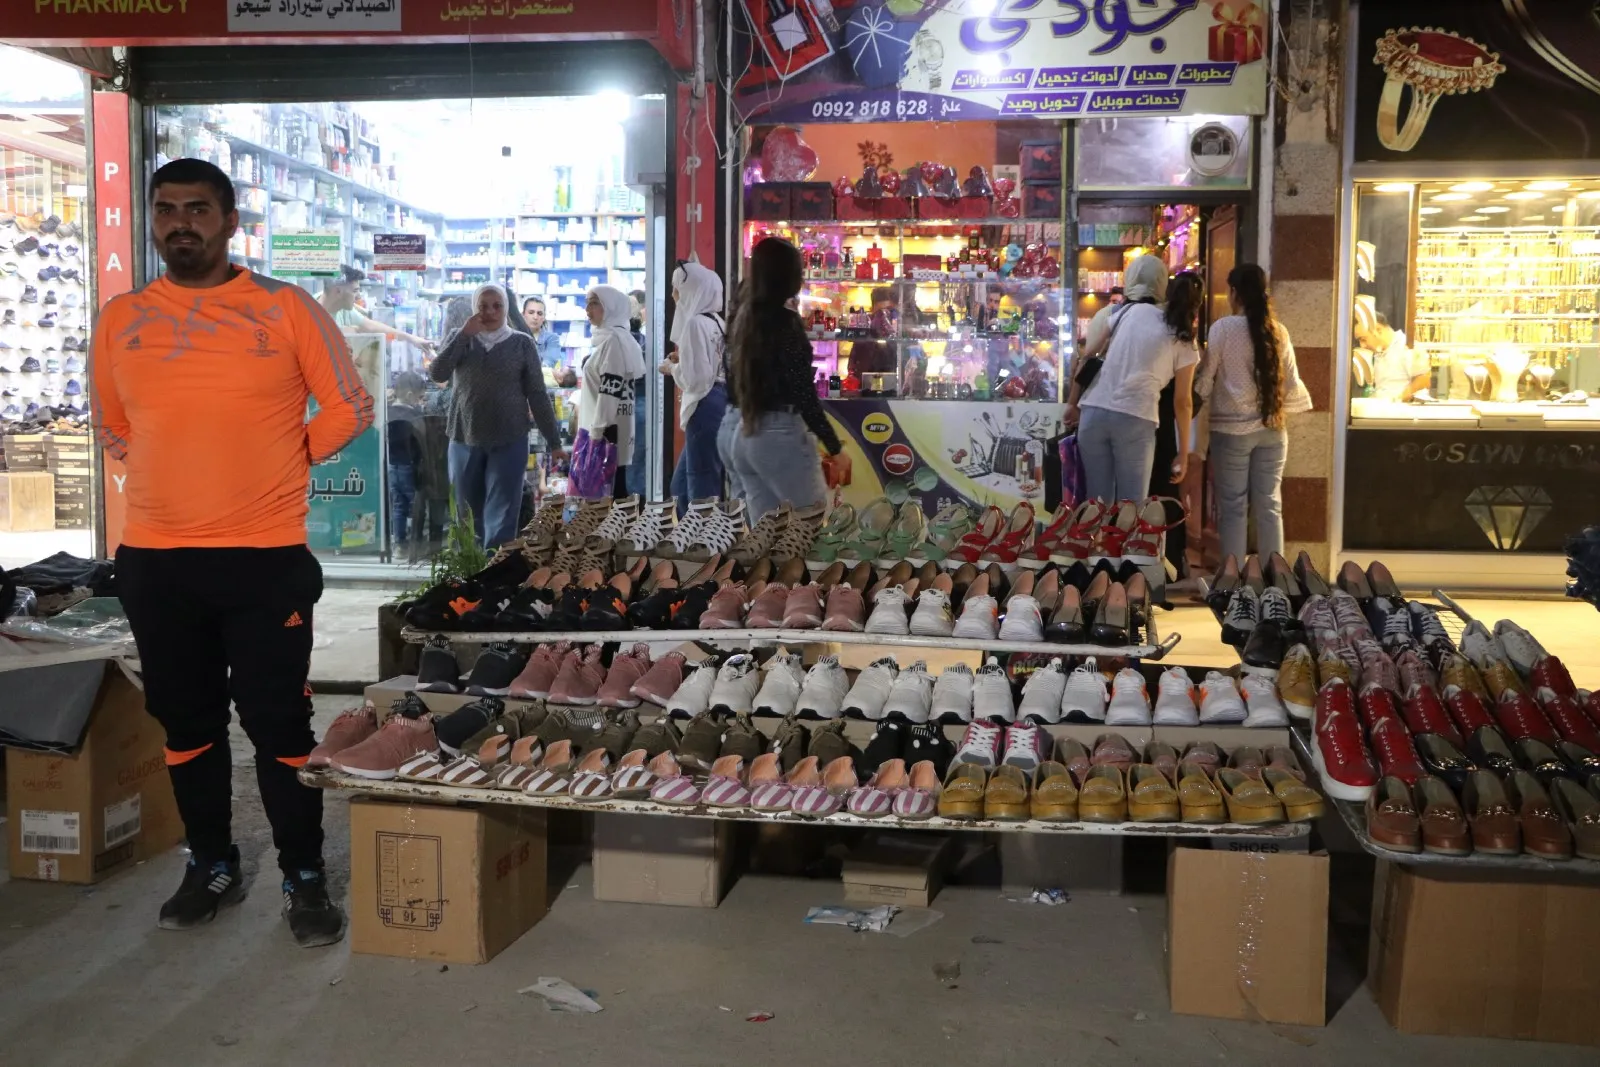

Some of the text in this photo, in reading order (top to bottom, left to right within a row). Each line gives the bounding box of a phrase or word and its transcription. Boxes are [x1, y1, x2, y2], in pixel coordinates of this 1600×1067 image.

[34, 0, 188, 14] PHARMACY
[440, 0, 574, 21] مستحضرات تجميل
[1037, 70, 1079, 87] تجميل
[1132, 69, 1168, 83] هدايا
[1178, 69, 1232, 85] عطورات
[812, 101, 855, 117] 0992
[859, 100, 891, 116] 818
[895, 99, 928, 115] 628
[1006, 94, 1181, 112] خدمات موبايل تحويل رصيد
[1228, 841, 1280, 854] SHOES
